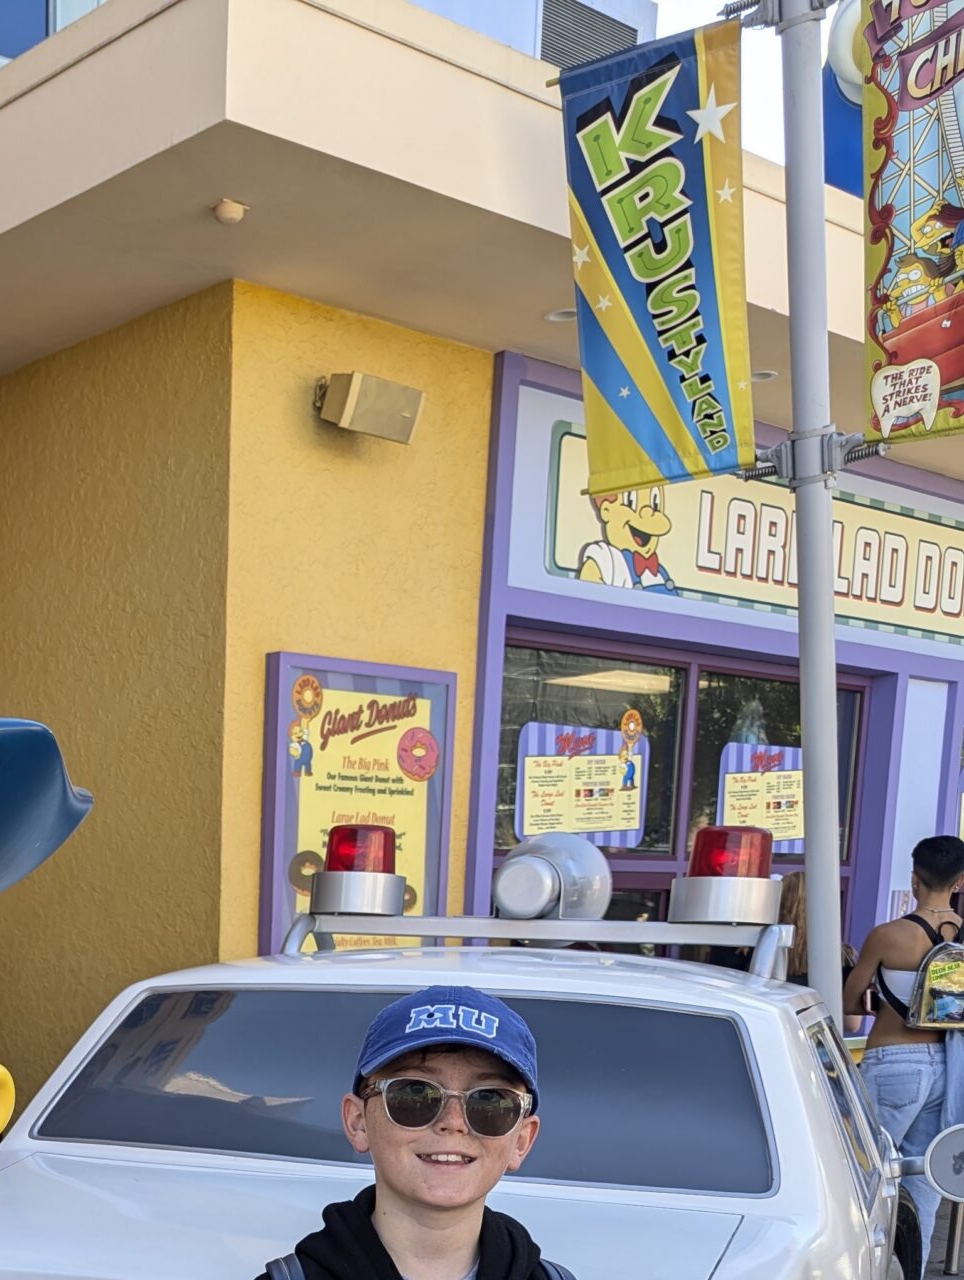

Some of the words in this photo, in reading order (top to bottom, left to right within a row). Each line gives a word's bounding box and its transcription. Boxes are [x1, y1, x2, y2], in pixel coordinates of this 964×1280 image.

[576, 60, 731, 456] KRUSTYLAND
[883, 371, 905, 386] THE
[908, 365, 933, 378] RIDE
[890, 376, 923, 391] THAT
[881, 404, 890, 418] A
[893, 393, 933, 410] NERVE!
[882, 383, 928, 405] STRIKES
[364, 692, 417, 728] Donuts
[342, 755, 357, 770] The
[357, 757, 371, 773] Big
[371, 759, 389, 771] Pink
[405, 1004, 499, 1039] MU
